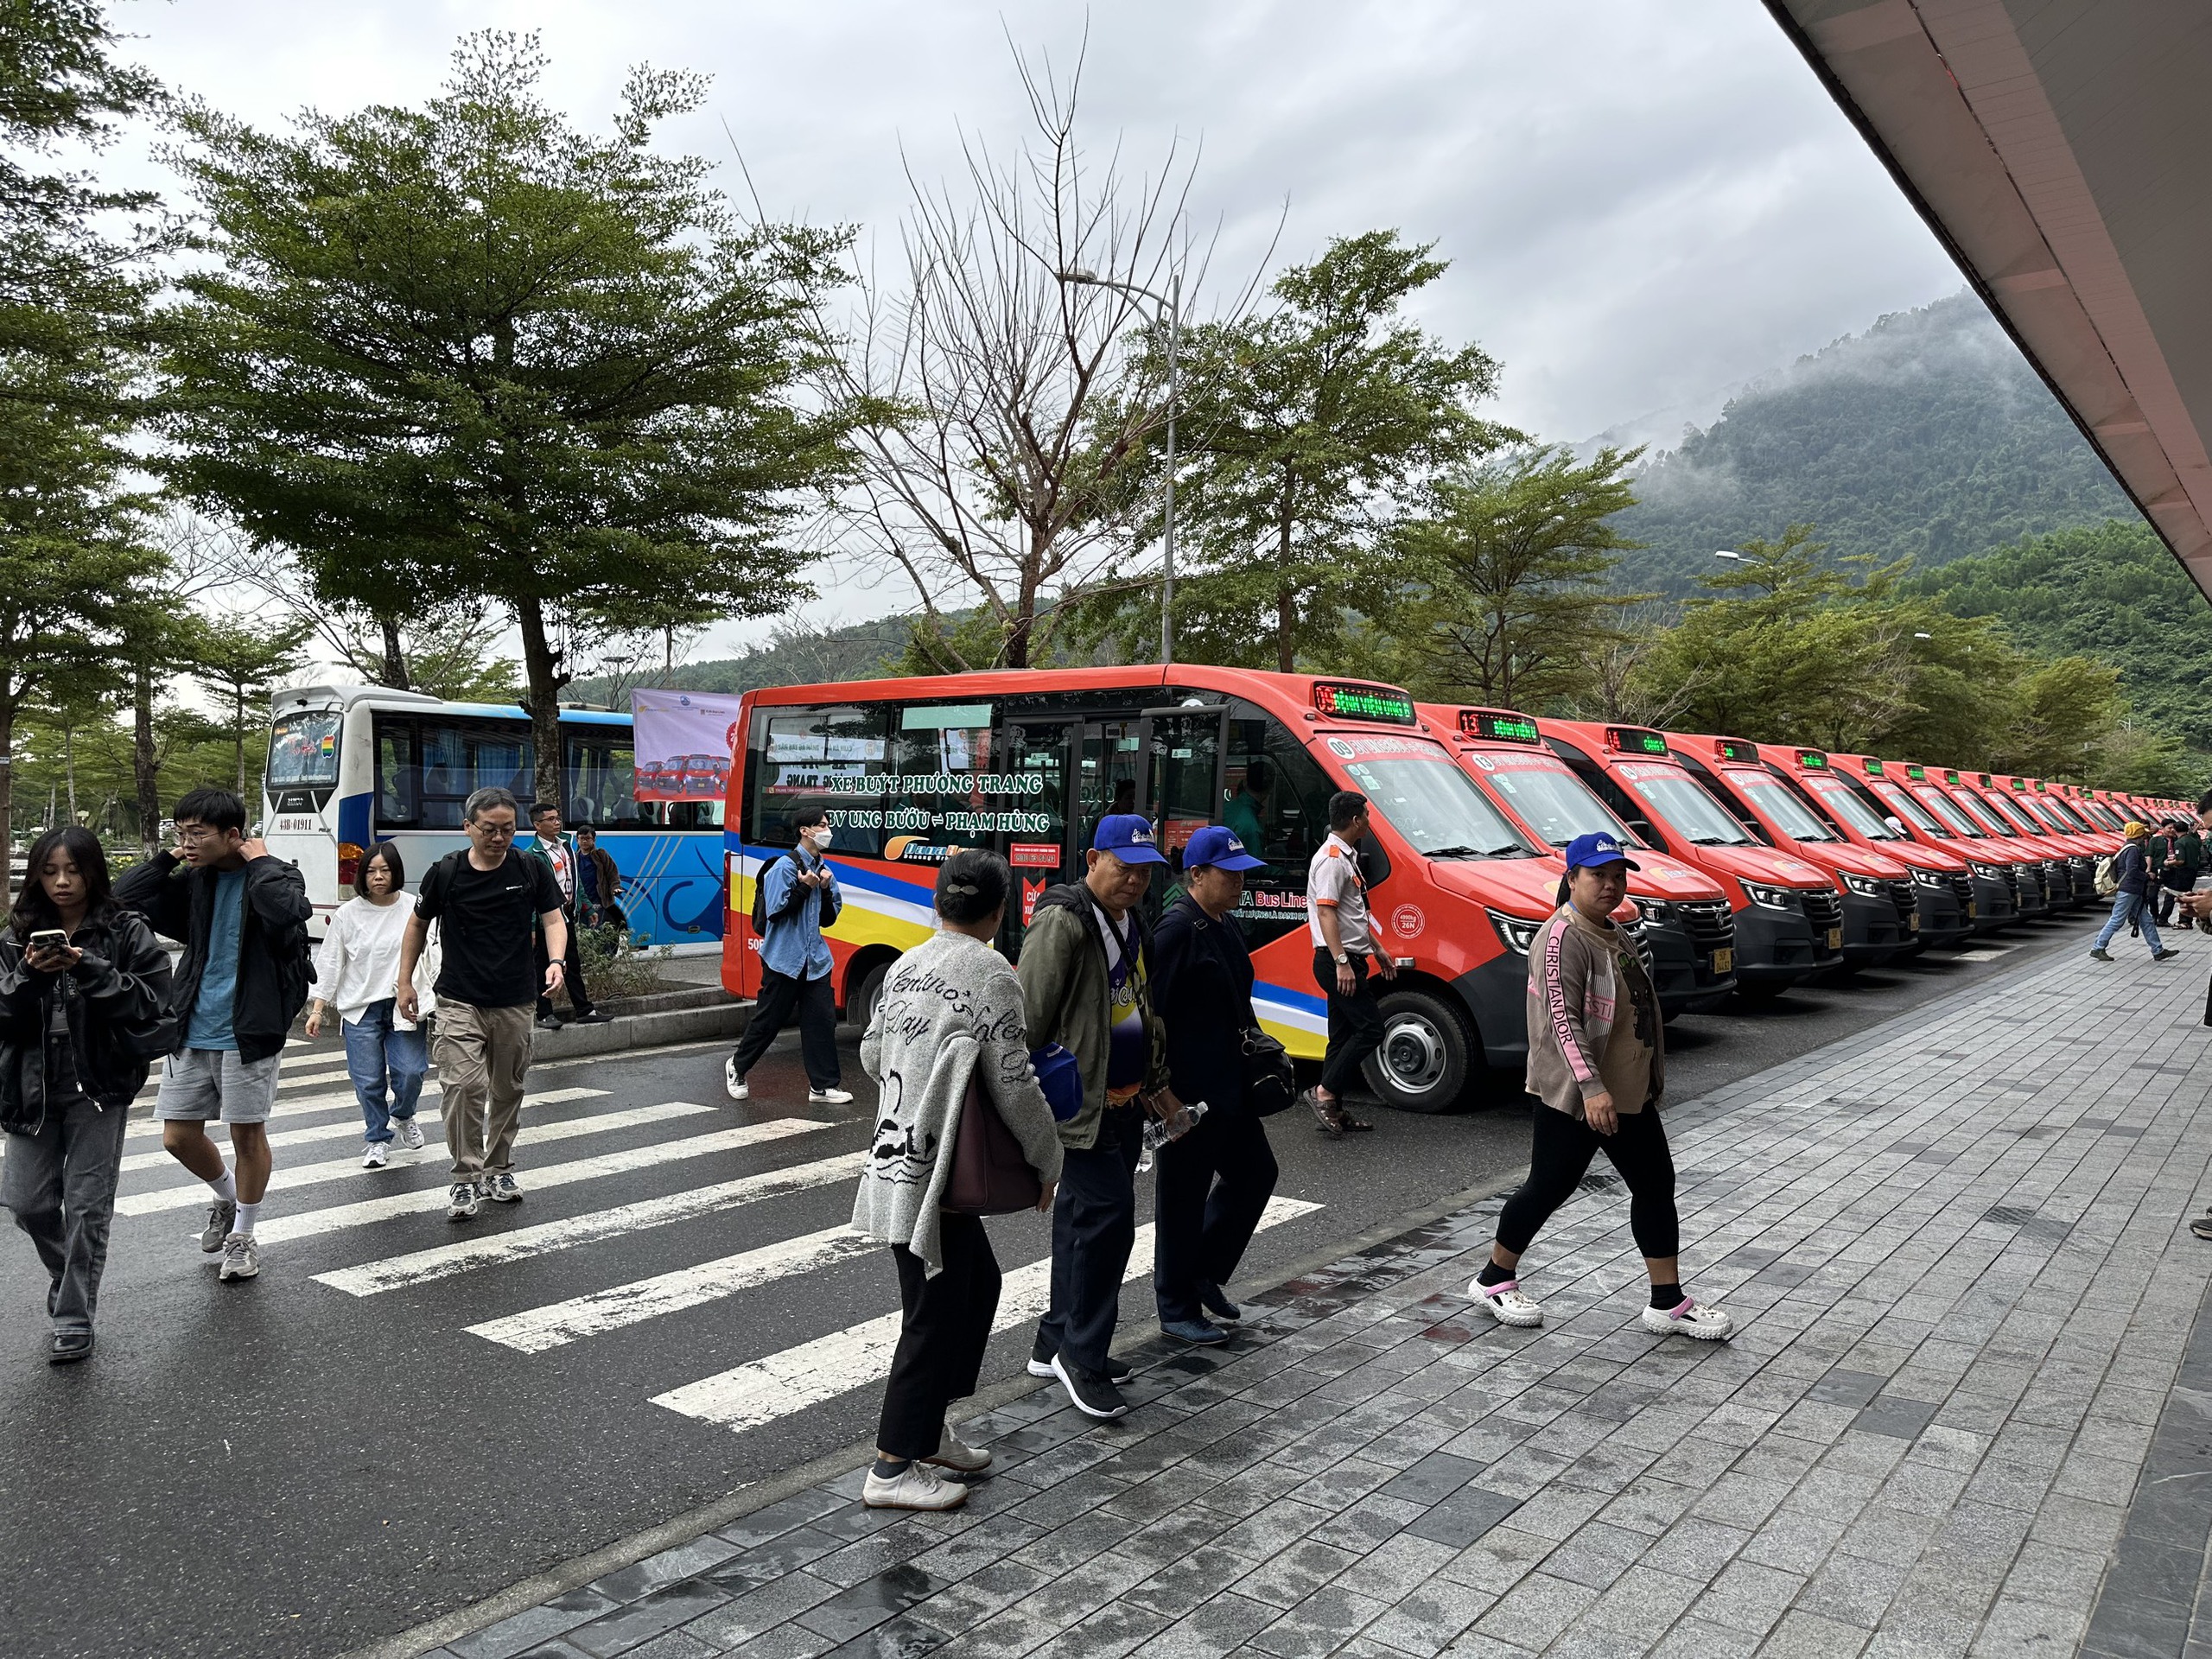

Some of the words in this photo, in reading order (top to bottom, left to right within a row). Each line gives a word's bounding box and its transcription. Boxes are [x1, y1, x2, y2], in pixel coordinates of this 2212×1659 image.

[1462, 714, 1479, 734] 13
[1329, 741, 1353, 756] 09
[1475, 757, 1493, 768] 13
[830, 775, 854, 794] XE
[855, 772, 900, 794] BUÝT
[902, 771, 975, 794] PHƯƠNG
[977, 774, 1043, 794] TRANG
[885, 807, 931, 830] BƯỚU
[945, 812, 995, 838] PHẠM
[997, 809, 1050, 832] HÙNG
[1255, 891, 1280, 907] Bus
[1281, 892, 1307, 908] Line
[1553, 1010, 1573, 1046] DIOR
